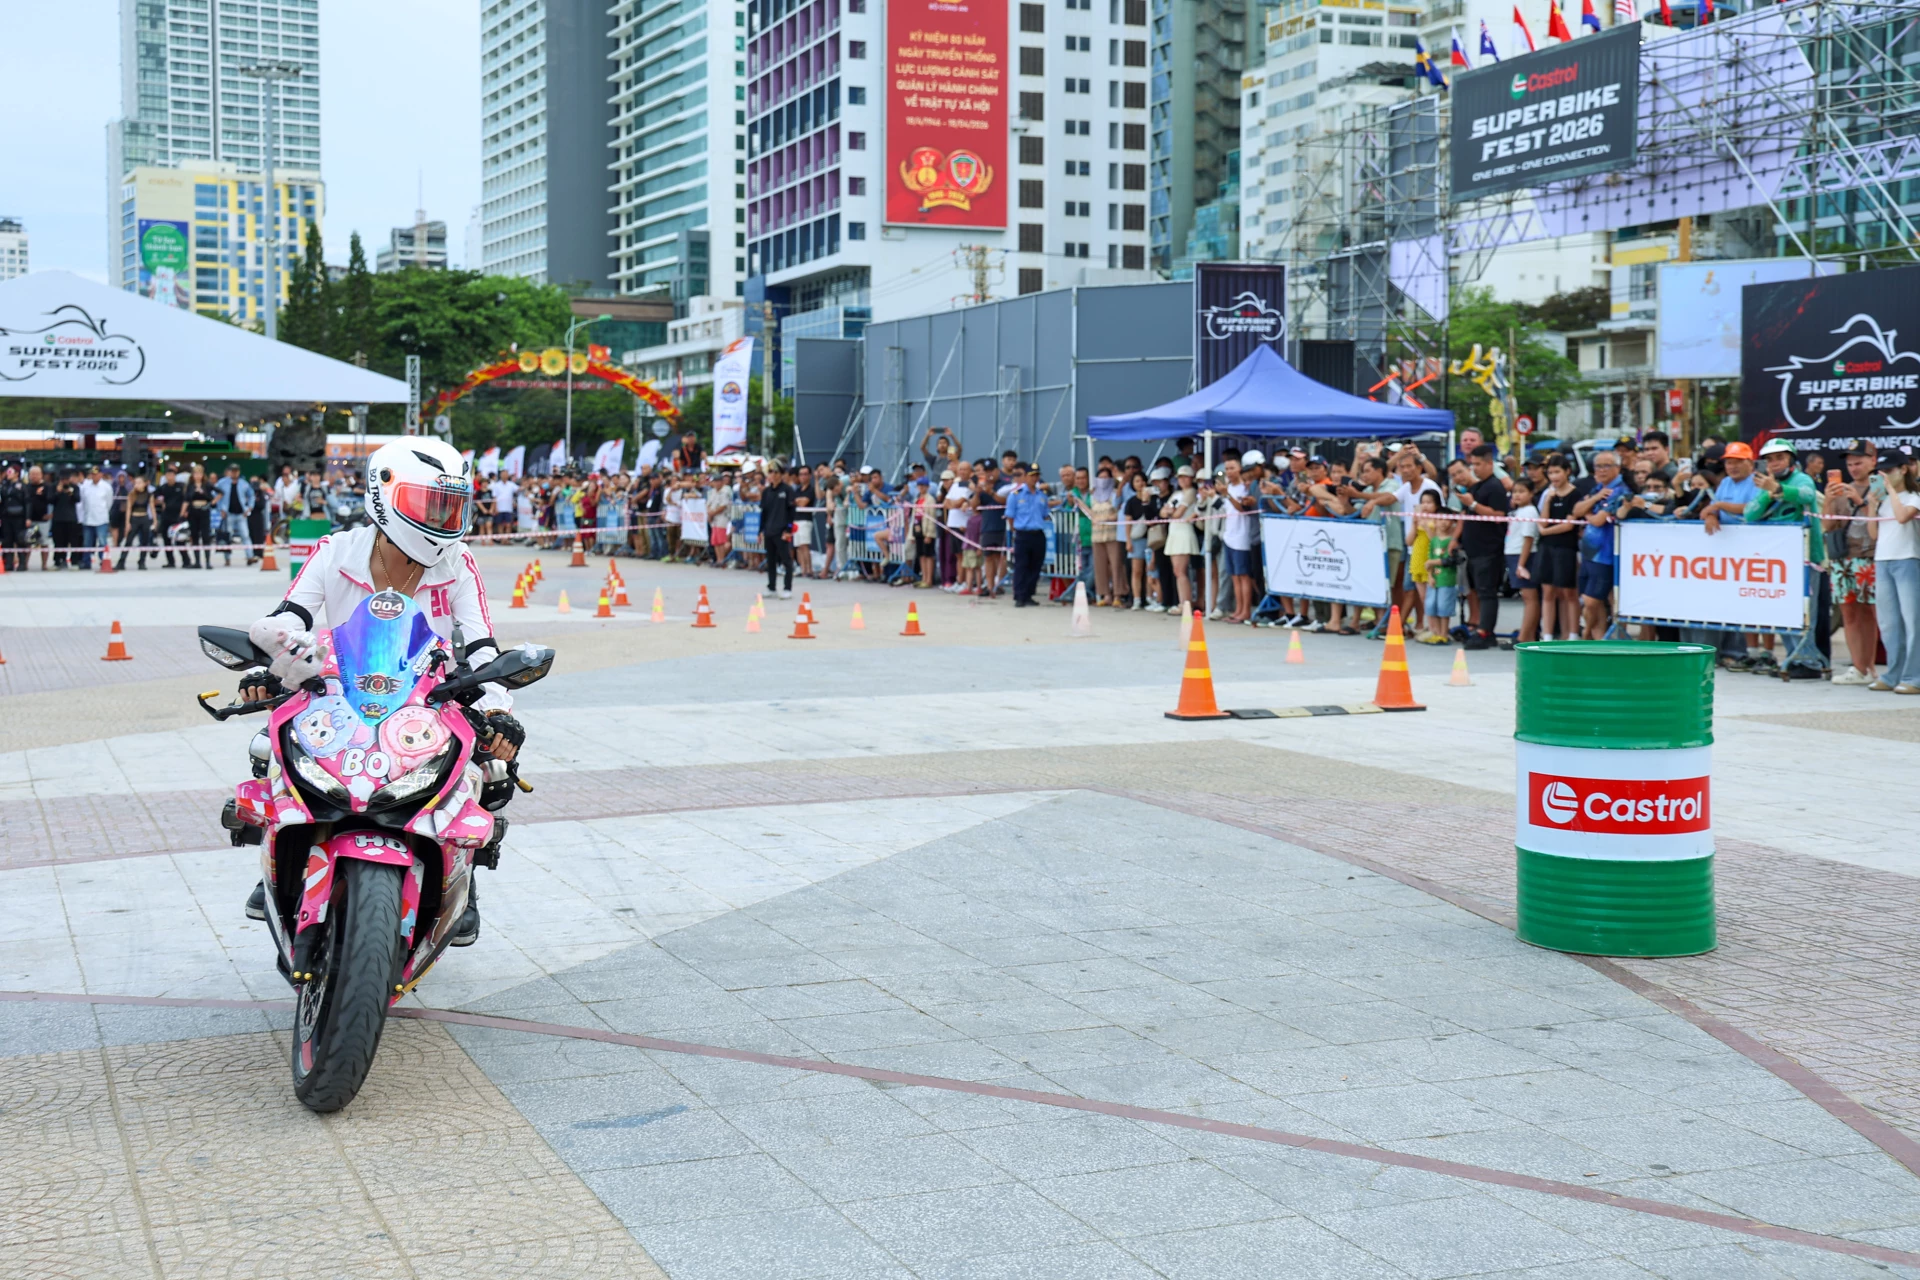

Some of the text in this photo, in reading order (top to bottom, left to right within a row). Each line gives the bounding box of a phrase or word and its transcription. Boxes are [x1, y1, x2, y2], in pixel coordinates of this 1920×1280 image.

[1527, 62, 1579, 92] Castrol
[1468, 83, 1621, 140] SUPERBIKE
[1479, 113, 1605, 163] FEST 2026
[1472, 170, 1492, 182] ONE
[1493, 163, 1516, 178] RIDE
[1522, 157, 1544, 171] ONE
[1544, 143, 1612, 167] CONNECTION
[57, 336, 93, 345] Castrol
[9, 346, 130, 359] SUPERBIKE
[20, 359, 118, 371] FEST 2026
[1845, 360, 1882, 373] Castrol
[1797, 374, 1919, 395] SUPERBIKE
[1807, 392, 1907, 412] FEST 2026
[1739, 587, 1786, 599] GROUP
[371, 600, 403, 612] 004
[341, 748, 390, 778] BO
[1584, 791, 1703, 822] Castrol
